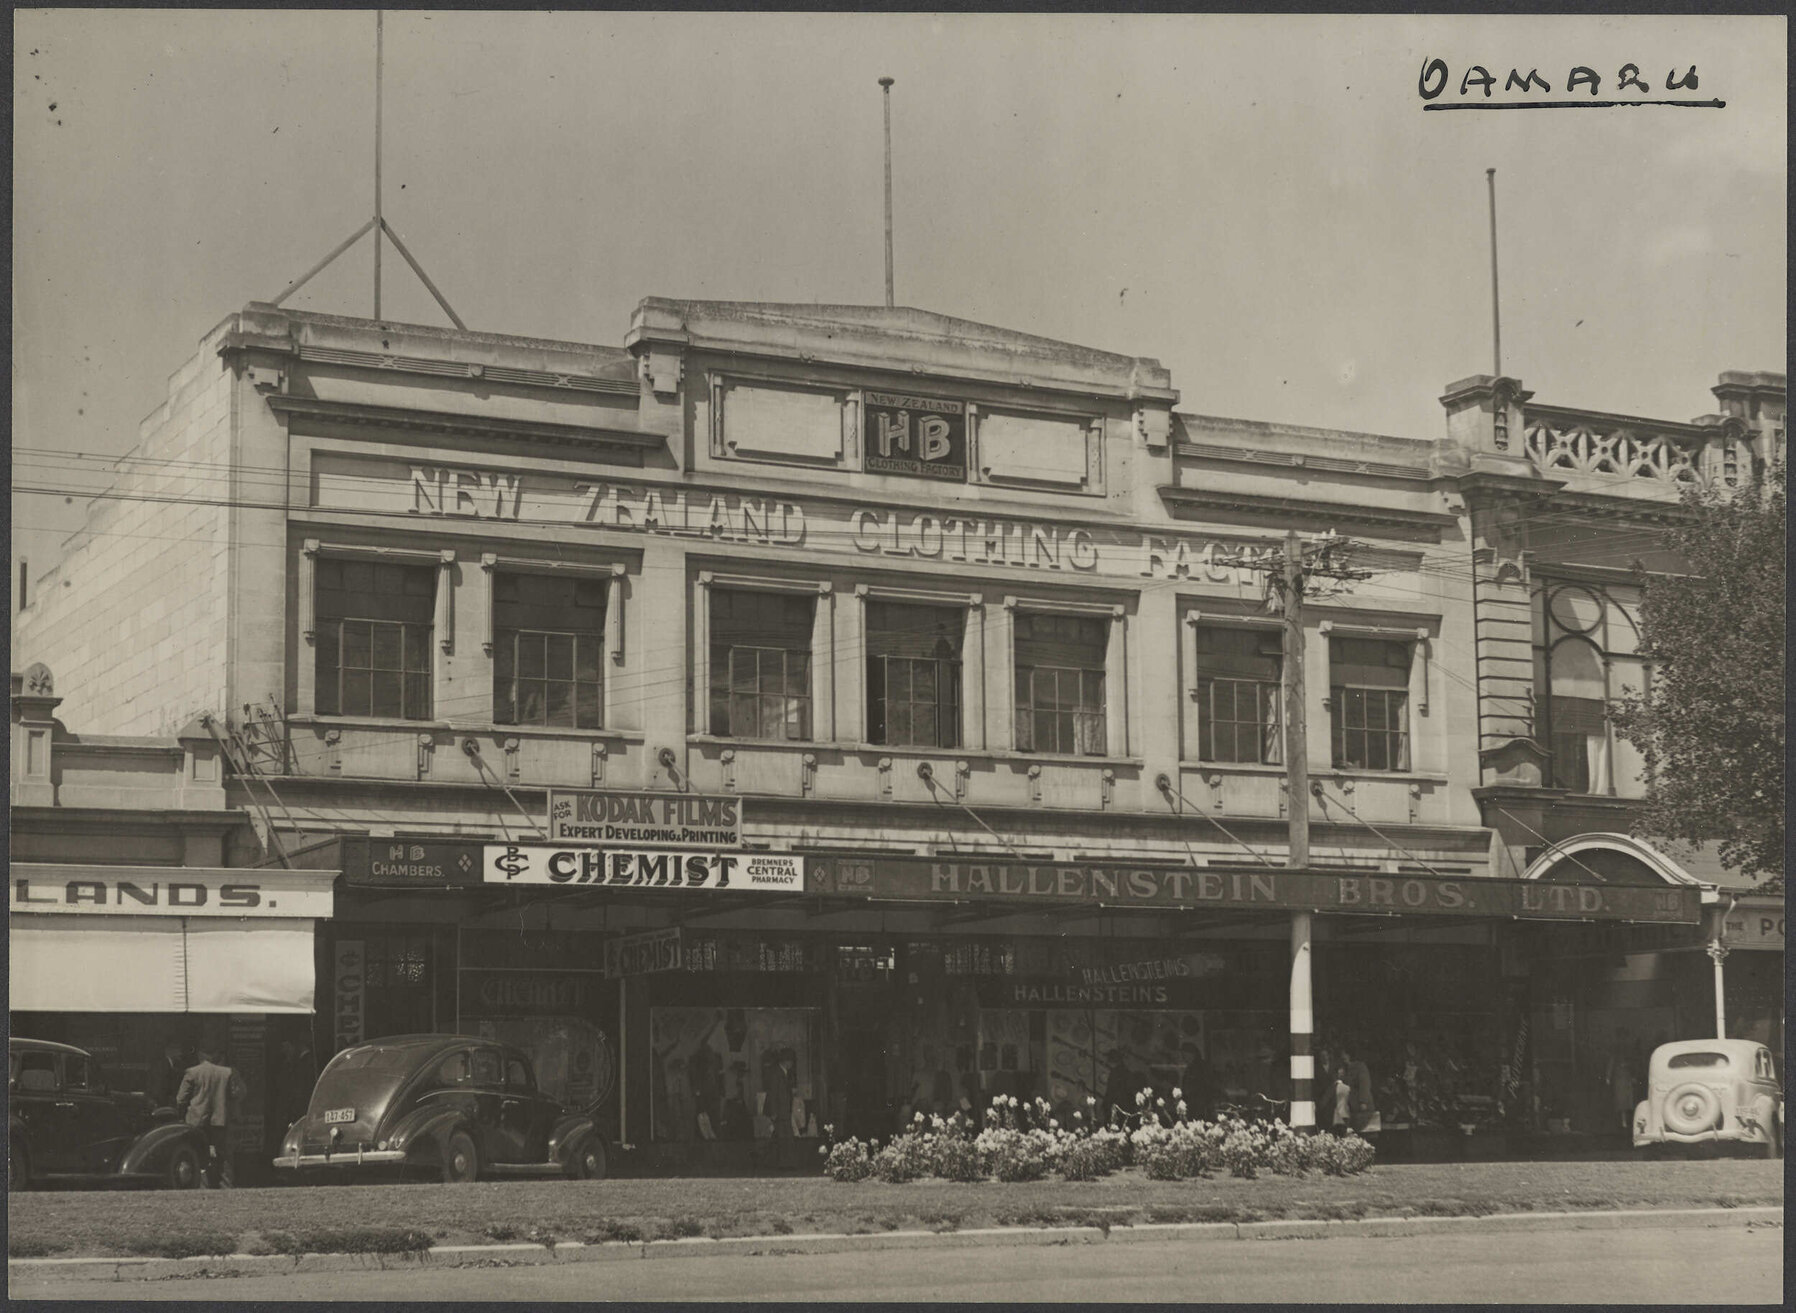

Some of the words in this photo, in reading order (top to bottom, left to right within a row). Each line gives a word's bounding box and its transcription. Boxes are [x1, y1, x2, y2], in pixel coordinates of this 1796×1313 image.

[871, 393, 897, 406] NEW
[901, 397, 958, 413] ZEALAND
[867, 458, 918, 472] CLOTHING
[920, 463, 961, 477] FACTORY
[407, 464, 522, 520] NEW
[573, 479, 807, 546] ZEALAND
[850, 508, 1098, 573] CLOTHING
[554, 800, 571, 812] ASK
[576, 793, 655, 824] KODAK
[663, 799, 738, 827] FILMS
[554, 811, 572, 821] FOR
[560, 823, 603, 839] EXPERT
[371, 862, 446, 878] CHAMBERS.
[546, 850, 739, 888] CHEMIST
[746, 866, 798, 877] CENTRAL
[751, 876, 795, 885] PHARMACY
[930, 864, 1277, 901] HALLENSTEIN
[1338, 877, 1476, 908] BROS.
[1519, 884, 1611, 913] LTD.
[16, 879, 277, 908] LANDS.
